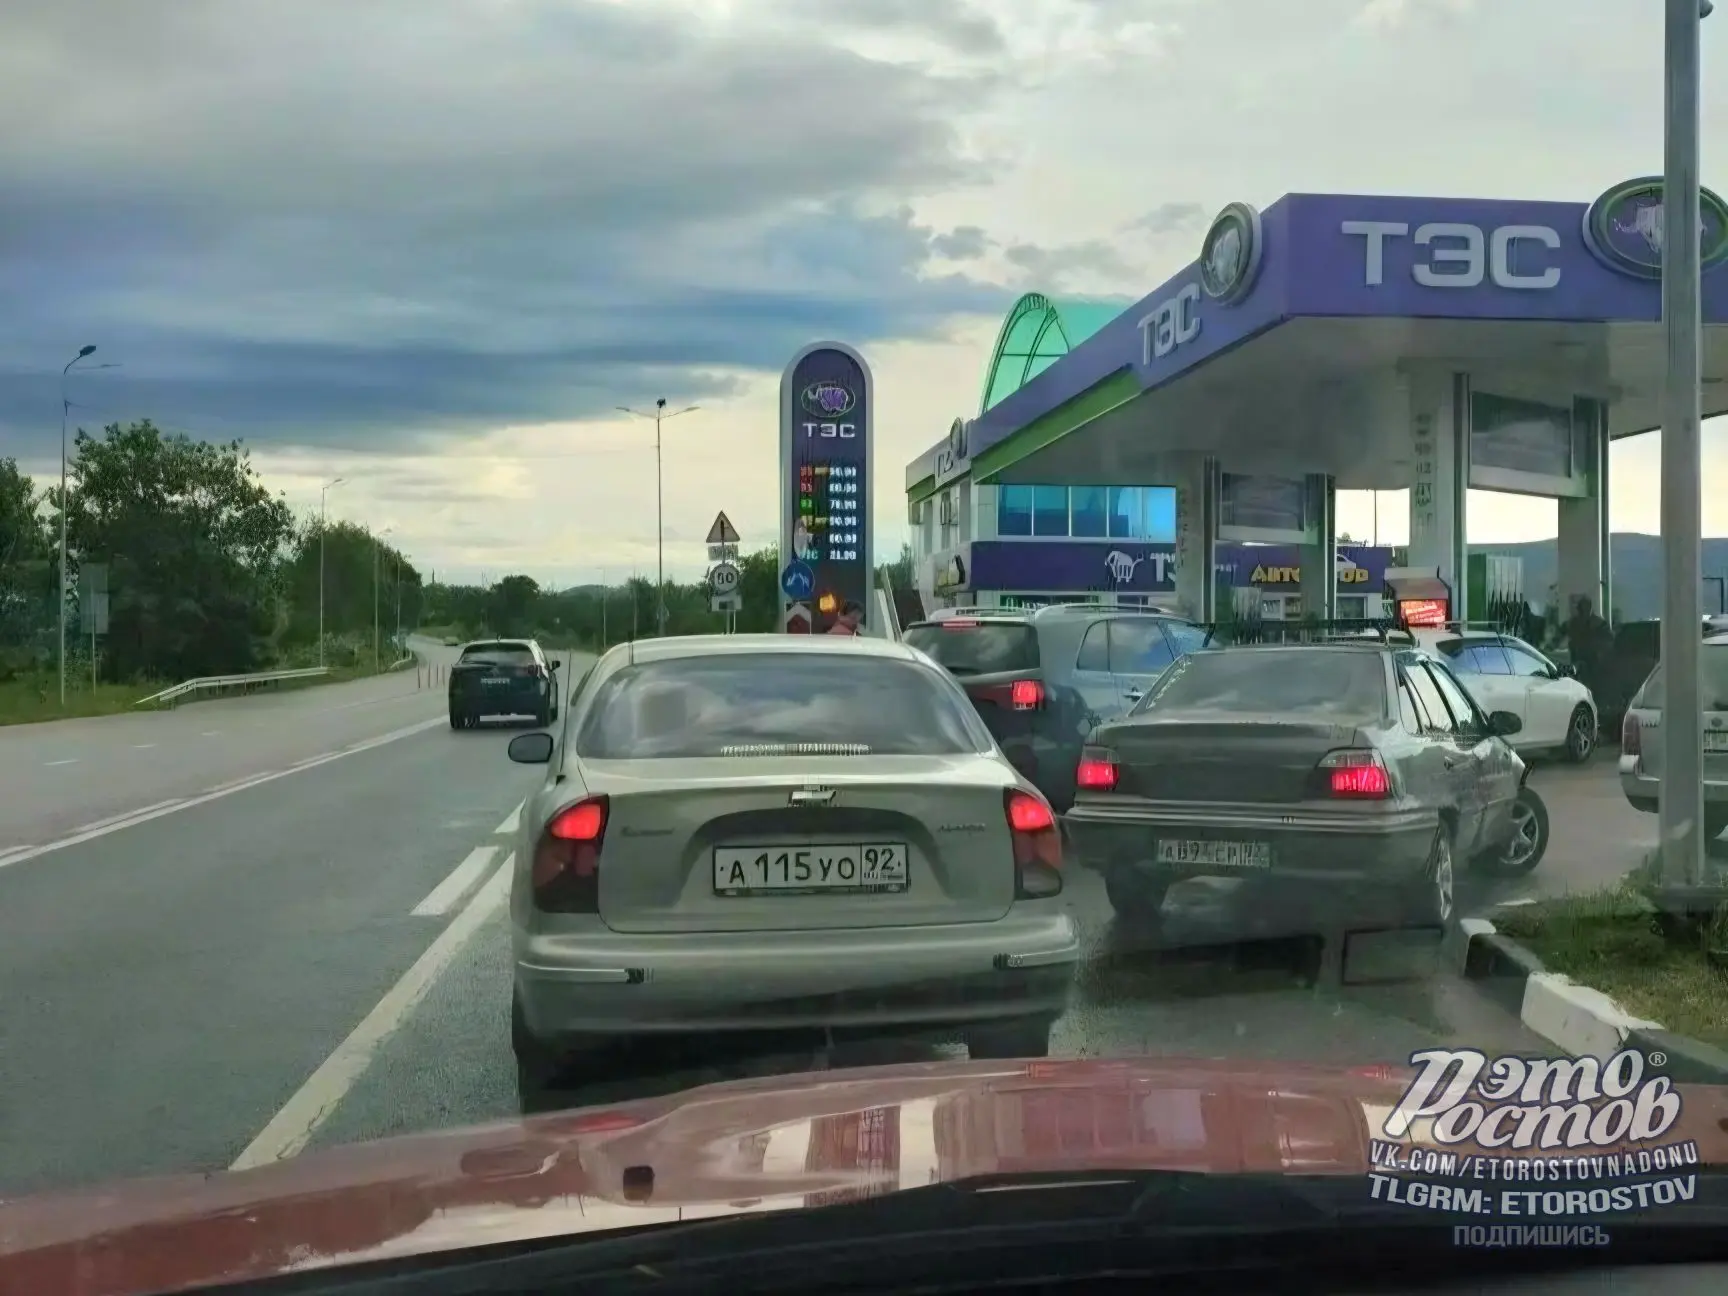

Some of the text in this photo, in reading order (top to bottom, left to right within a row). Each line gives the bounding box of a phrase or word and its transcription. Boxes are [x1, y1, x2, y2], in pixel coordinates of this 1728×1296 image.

[1341, 220, 1561, 289] ТЭС
[1137, 282, 1201, 366] ТЭС
[802, 423, 856, 438] ТЭС
[729, 848, 895, 884] А115УО 92
